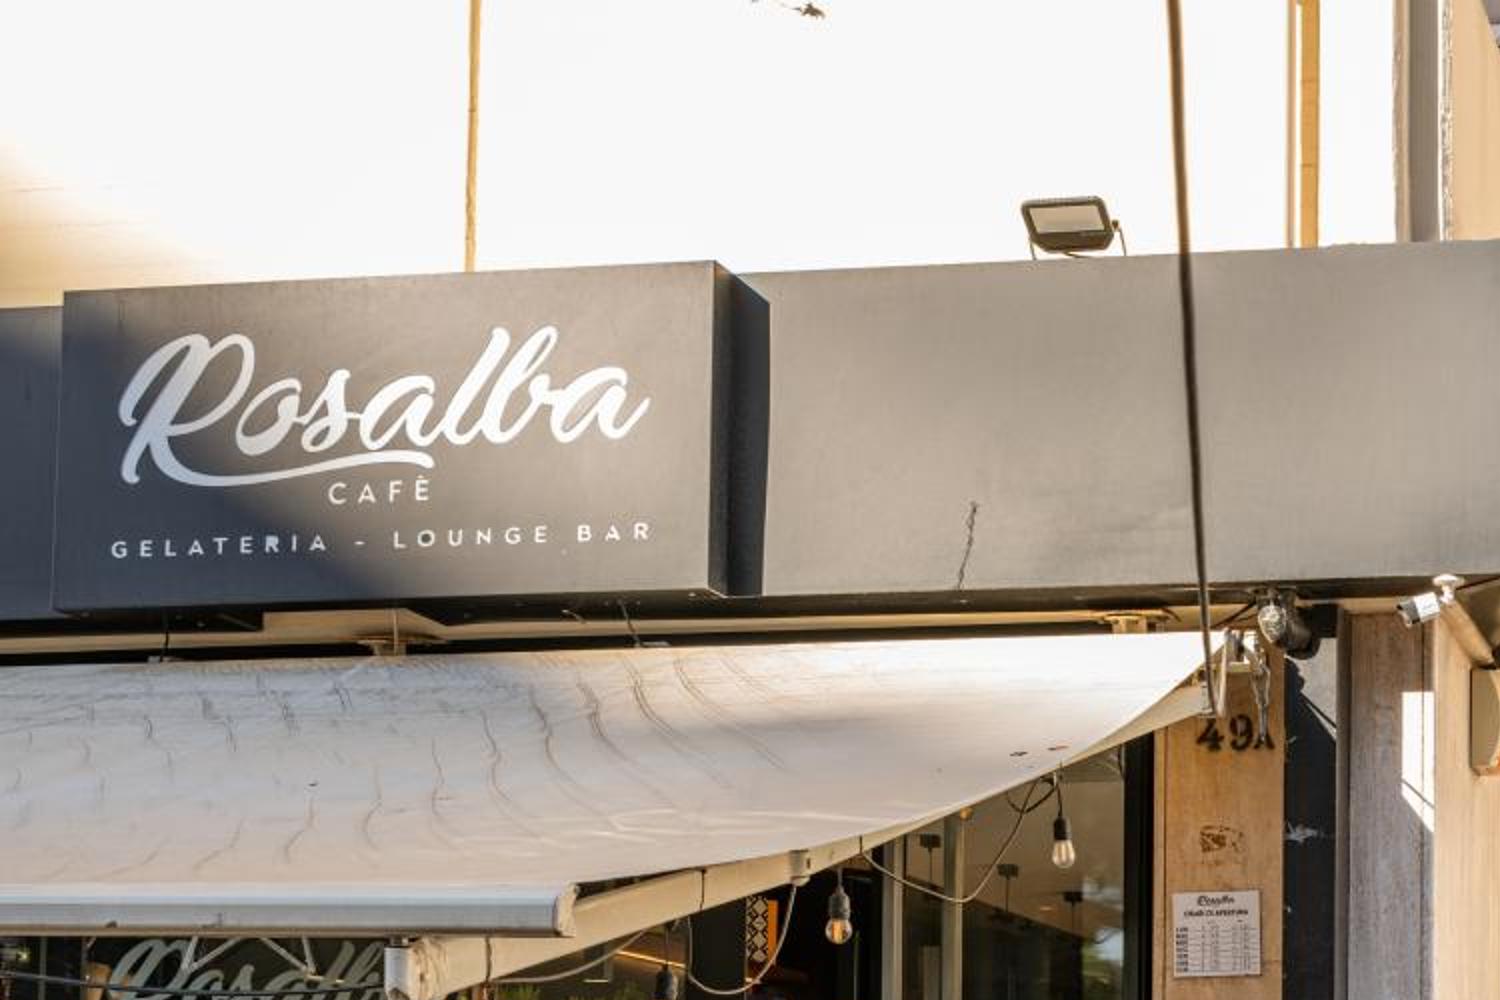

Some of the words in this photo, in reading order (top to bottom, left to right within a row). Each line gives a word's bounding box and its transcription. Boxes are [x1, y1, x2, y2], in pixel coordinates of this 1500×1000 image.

[118, 326, 650, 487] Rosalba
[111, 534, 326, 559] GELATERIA
[392, 525, 548, 550] LOUNGE
[577, 522, 649, 543] BAR
